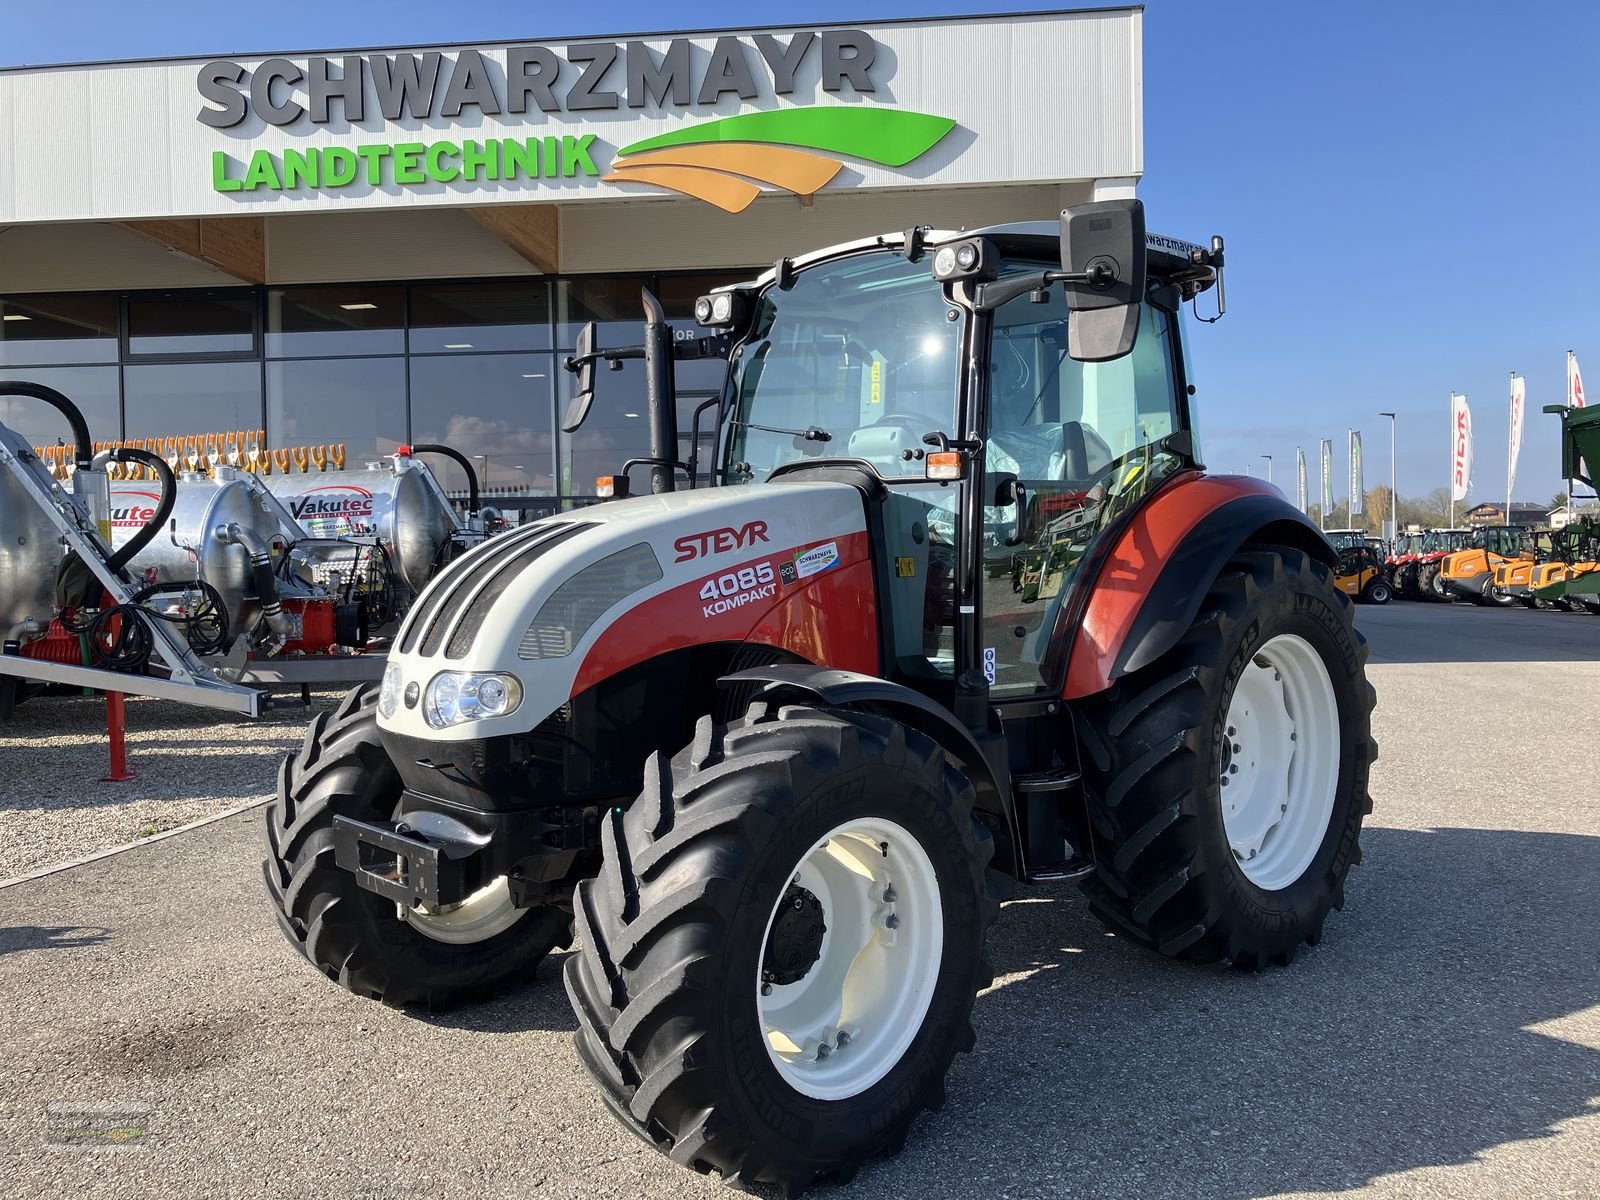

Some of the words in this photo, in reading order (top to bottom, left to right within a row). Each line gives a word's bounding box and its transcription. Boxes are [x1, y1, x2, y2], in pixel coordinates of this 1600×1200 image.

[197, 29, 878, 129] SCHWARZMAYR
[212, 134, 599, 193] LANDTECHNIK
[673, 330, 695, 340] OR
[290, 496, 373, 520] Vakutec
[673, 520, 770, 563] STEYR
[799, 549, 832, 564] SCHWARZMAYR
[699, 561, 775, 601] 4085
[781, 566, 794, 577] eco
[703, 583, 777, 618] KOMPAKT
